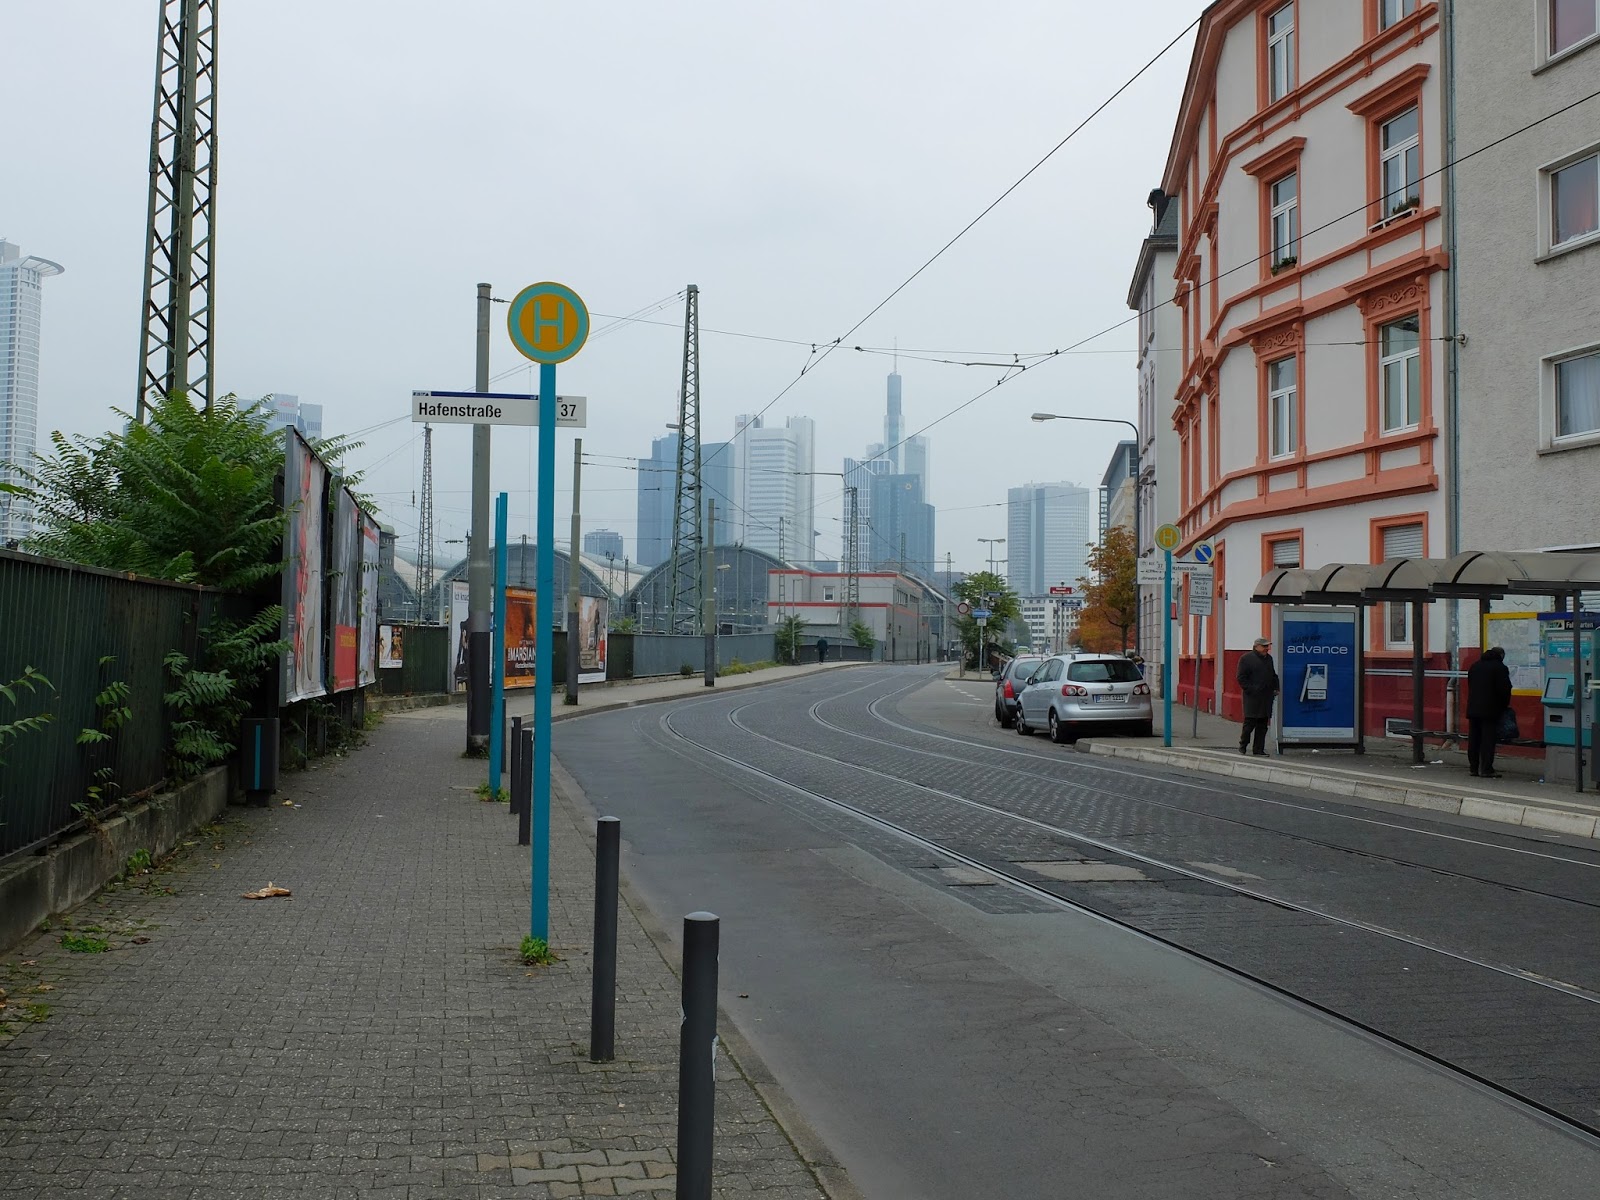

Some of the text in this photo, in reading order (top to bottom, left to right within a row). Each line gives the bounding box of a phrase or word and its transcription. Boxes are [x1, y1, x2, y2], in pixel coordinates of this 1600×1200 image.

[533, 301, 565, 345] H
[418, 402, 502, 418] Hafenstraße
[560, 404, 577, 418] 37
[1163, 530, 1173, 546] H
[1286, 643, 1348, 655] advance
